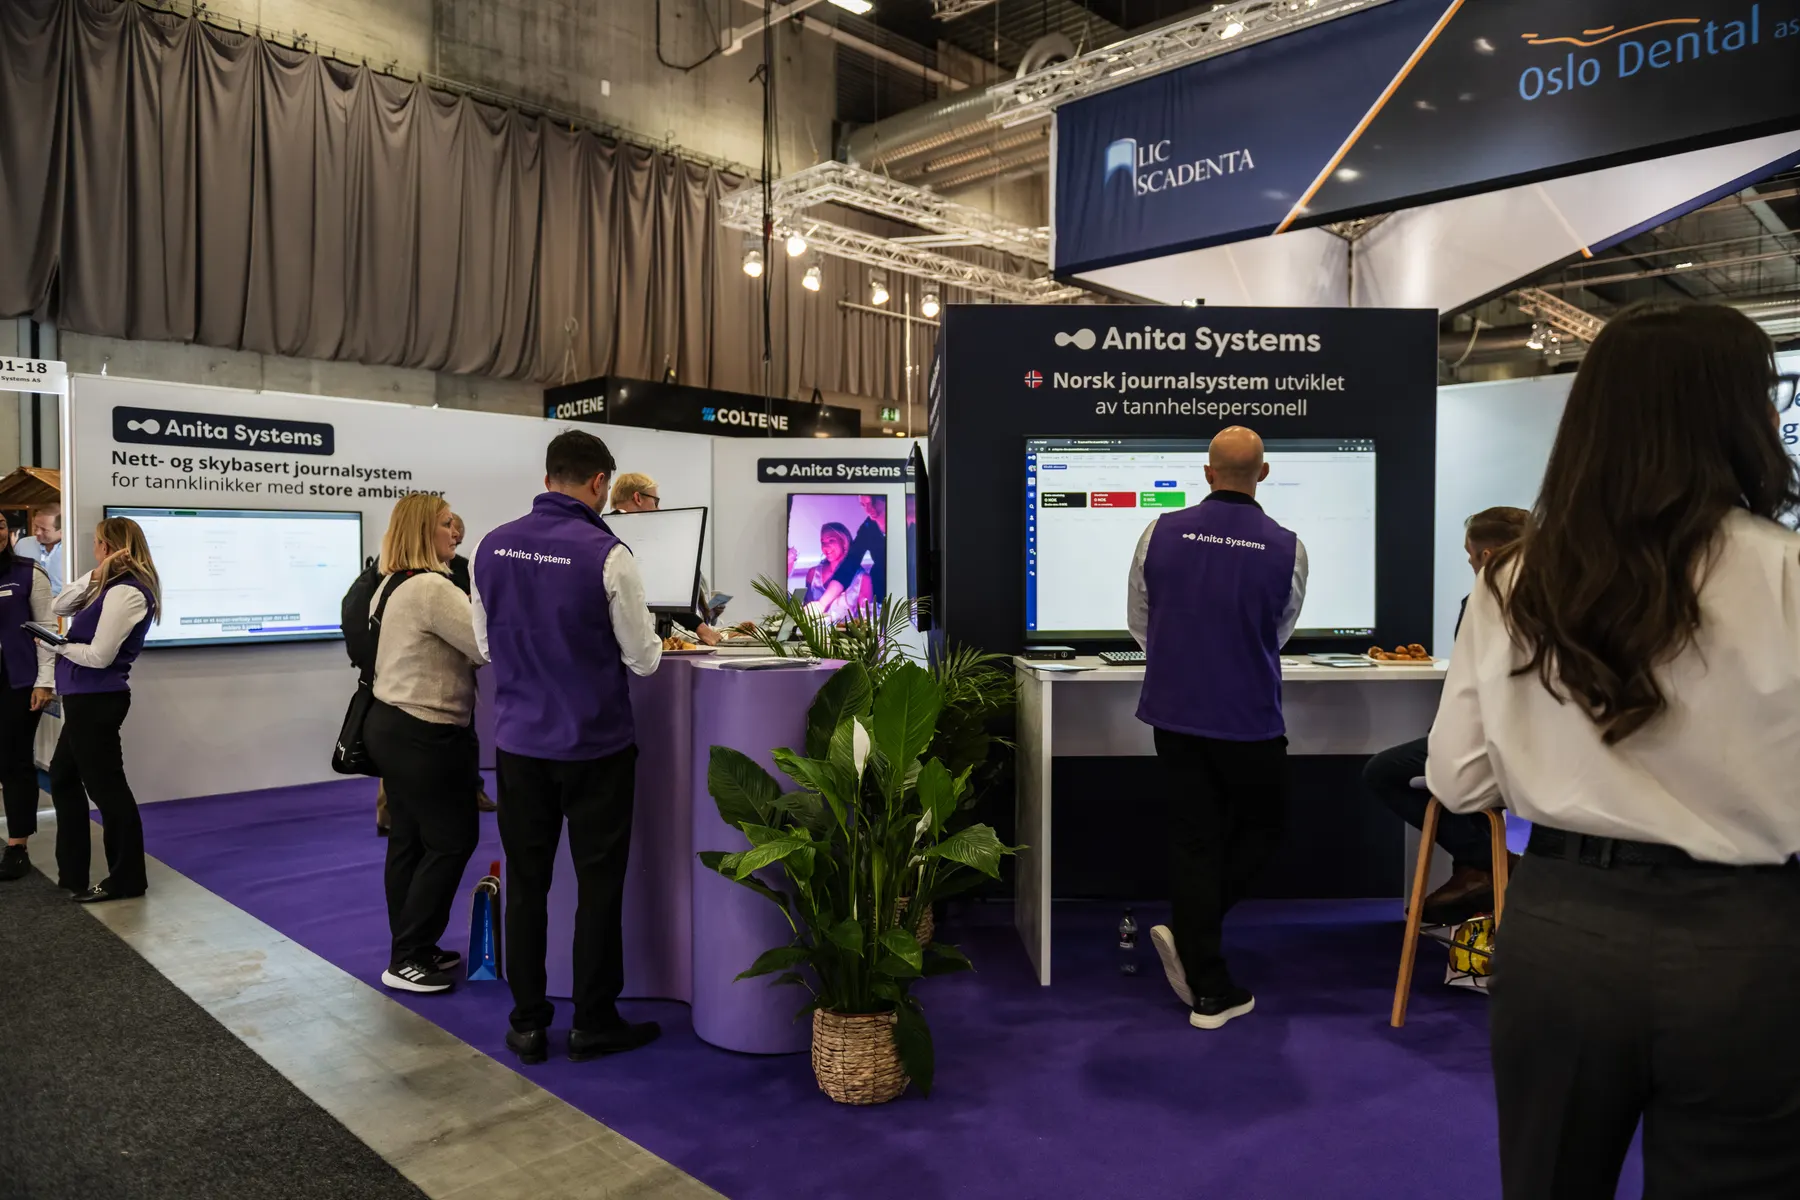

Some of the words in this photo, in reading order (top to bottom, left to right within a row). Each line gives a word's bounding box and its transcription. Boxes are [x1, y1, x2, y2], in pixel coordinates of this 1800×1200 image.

[1518, 53, 1601, 101] Oslo
[1617, 3, 1760, 79] Dental
[1138, 139, 1171, 168] LIC
[1137, 148, 1255, 197] SCADENTA
[1102, 326, 1186, 350] Anita
[1194, 327, 1322, 358] Systems
[1053, 372, 1116, 389] Norsk
[1119, 372, 1269, 394] journalsystem
[1274, 374, 1345, 391] utviklet
[556, 395, 605, 419] COLTENE
[717, 407, 789, 431] COLTENE
[1095, 400, 1118, 415] av
[1122, 398, 1308, 420] tannhelsepersonell
[164, 419, 229, 440] Anita
[233, 424, 324, 447] Systems
[111, 450, 165, 468] Nett-
[170, 457, 194, 472] og
[198, 455, 290, 474] skybasert
[292, 461, 413, 483] journalsystem
[790, 463, 833, 476] Anita
[836, 464, 901, 479] Systems
[111, 471, 140, 487] for
[145, 474, 263, 493] tannklinikker
[267, 481, 304, 495] med
[309, 483, 353, 496] store
[1197, 533, 1223, 544] Anita
[1225, 537, 1266, 551] Systems
[506, 548, 532, 560] Anita
[533, 552, 571, 565] Systems
